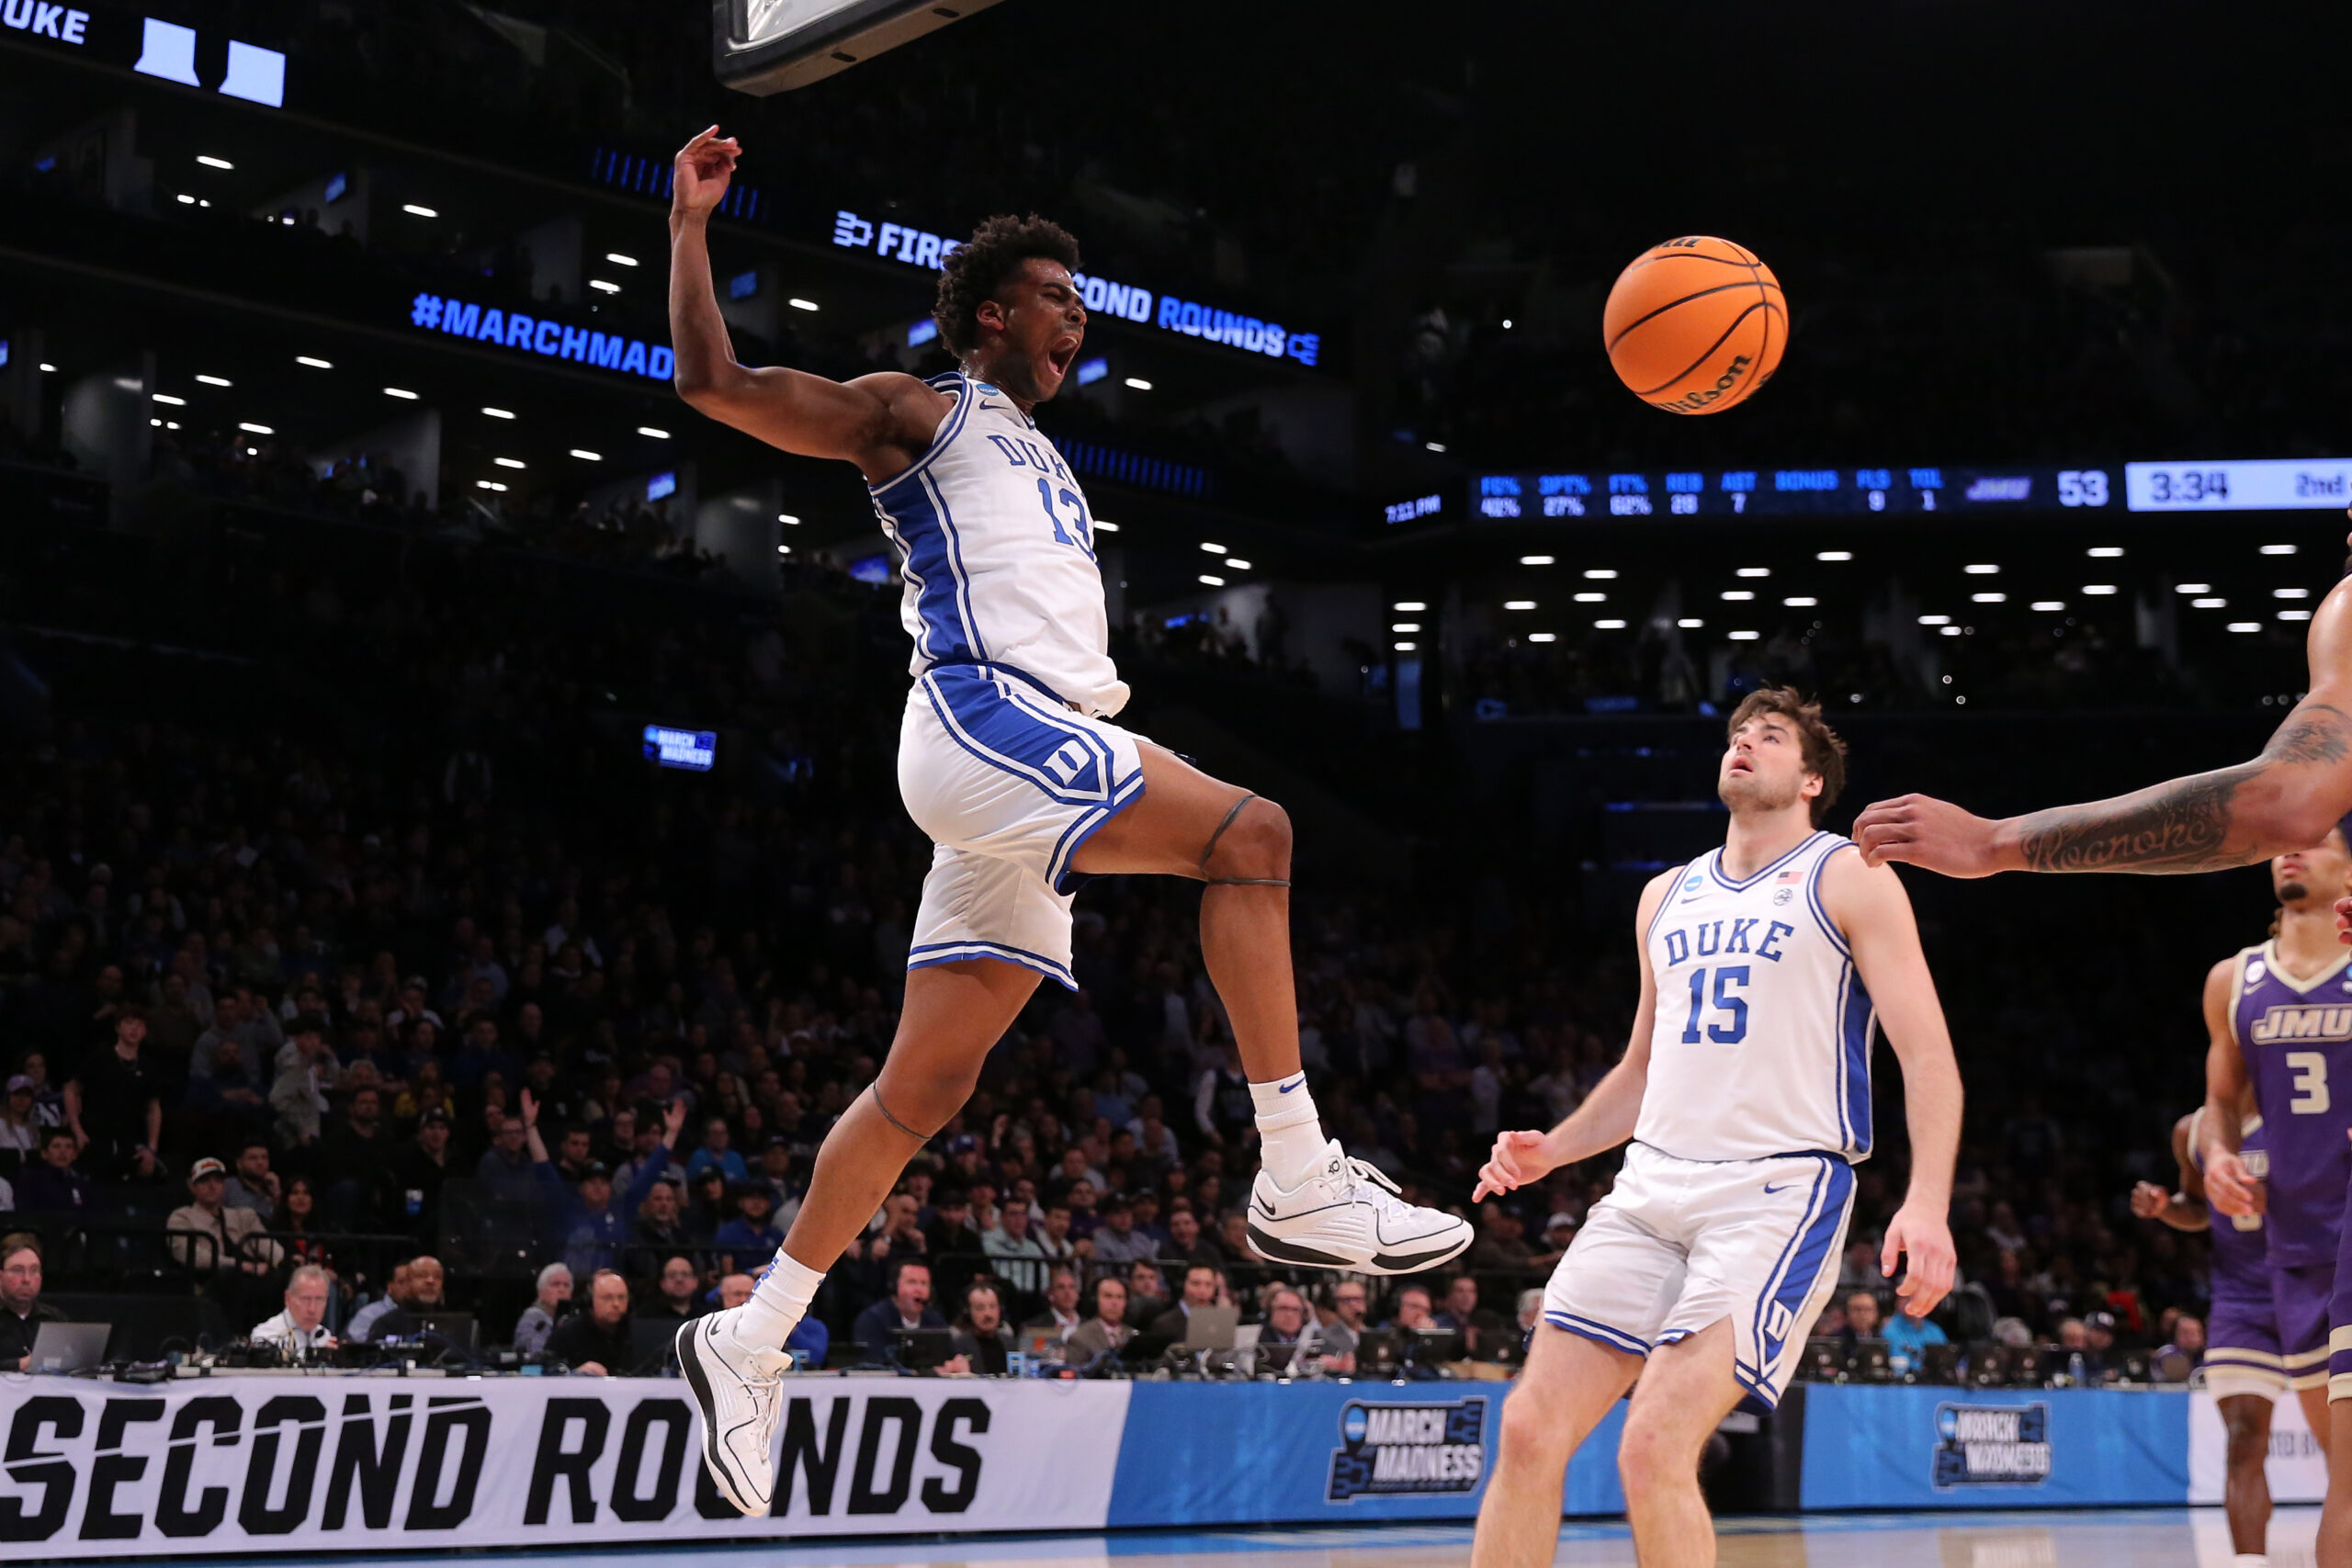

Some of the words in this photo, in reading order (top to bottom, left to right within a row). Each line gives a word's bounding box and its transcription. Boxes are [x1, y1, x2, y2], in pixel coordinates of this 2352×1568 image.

[0, 0, 89, 44] UKE
[412, 293, 674, 380] #MARCHMAD
[1158, 295, 1285, 357] ROUNDS
[986, 434, 1083, 496] DUK
[1775, 470, 1838, 491] BONUS
[1730, 492, 1746, 513] 7
[1868, 491, 1885, 511] 9
[1921, 490, 1937, 511] 1
[2057, 470, 2109, 506] 53
[2152, 473, 2227, 502] 3:34
[2297, 474, 2346, 497] 2nd
[1037, 477, 1095, 562] 13
[1664, 919, 1794, 967] DUKE
[1681, 965, 1750, 1044] 15
[2253, 1008, 2352, 1041] JMU
[2286, 1051, 2331, 1114] 3
[1365, 1408, 1448, 1445] MARCH
[1955, 1411, 2021, 1442] MARCH
[0, 1393, 492, 1542] SECOND
[1373, 1444, 1483, 1483] MADNESS
[1964, 1442, 2051, 1474] MADNESS
